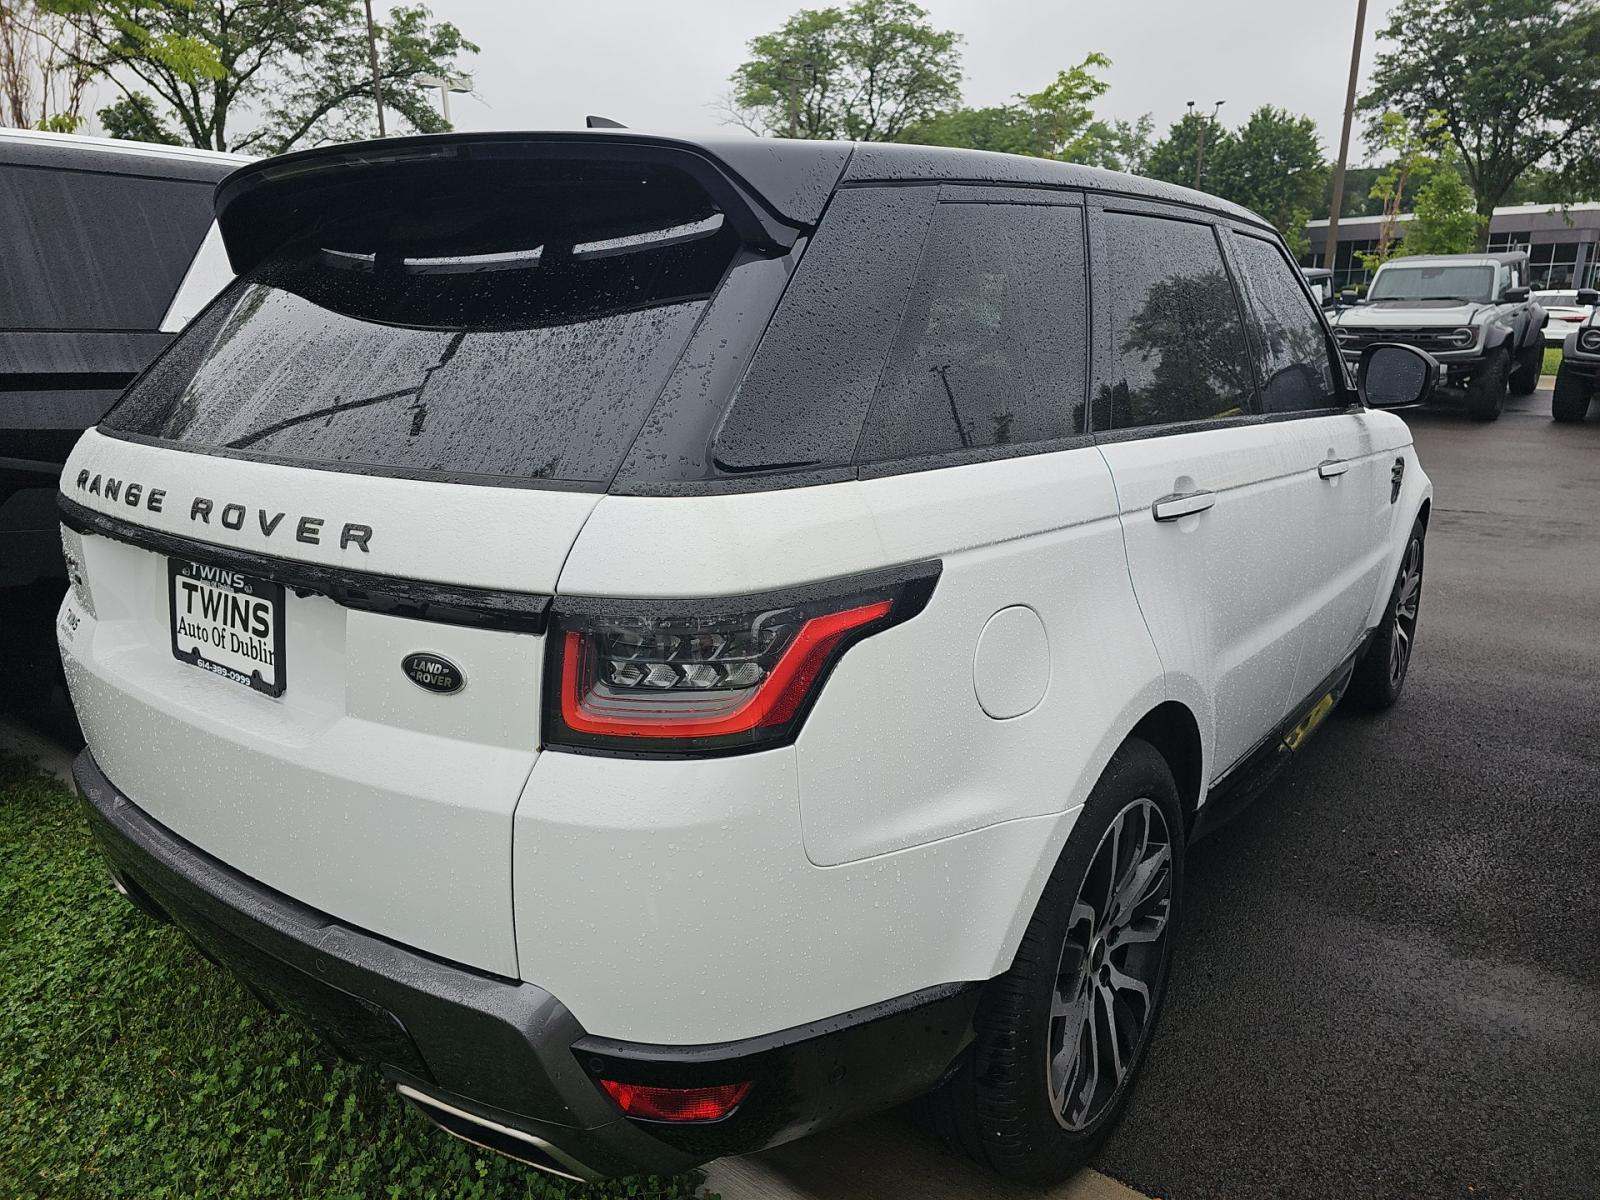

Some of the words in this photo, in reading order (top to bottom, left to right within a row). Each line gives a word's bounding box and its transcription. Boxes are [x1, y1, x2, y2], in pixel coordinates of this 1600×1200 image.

[77, 468, 167, 513] RANGE
[190, 496, 373, 553] ROVER
[190, 562, 245, 588] TWINS
[181, 581, 270, 639] TWINS
[177, 615, 209, 643] Auto
[212, 626, 226, 650] Of
[413, 659, 443, 675] LAND
[416, 670, 452, 688] ROVER
